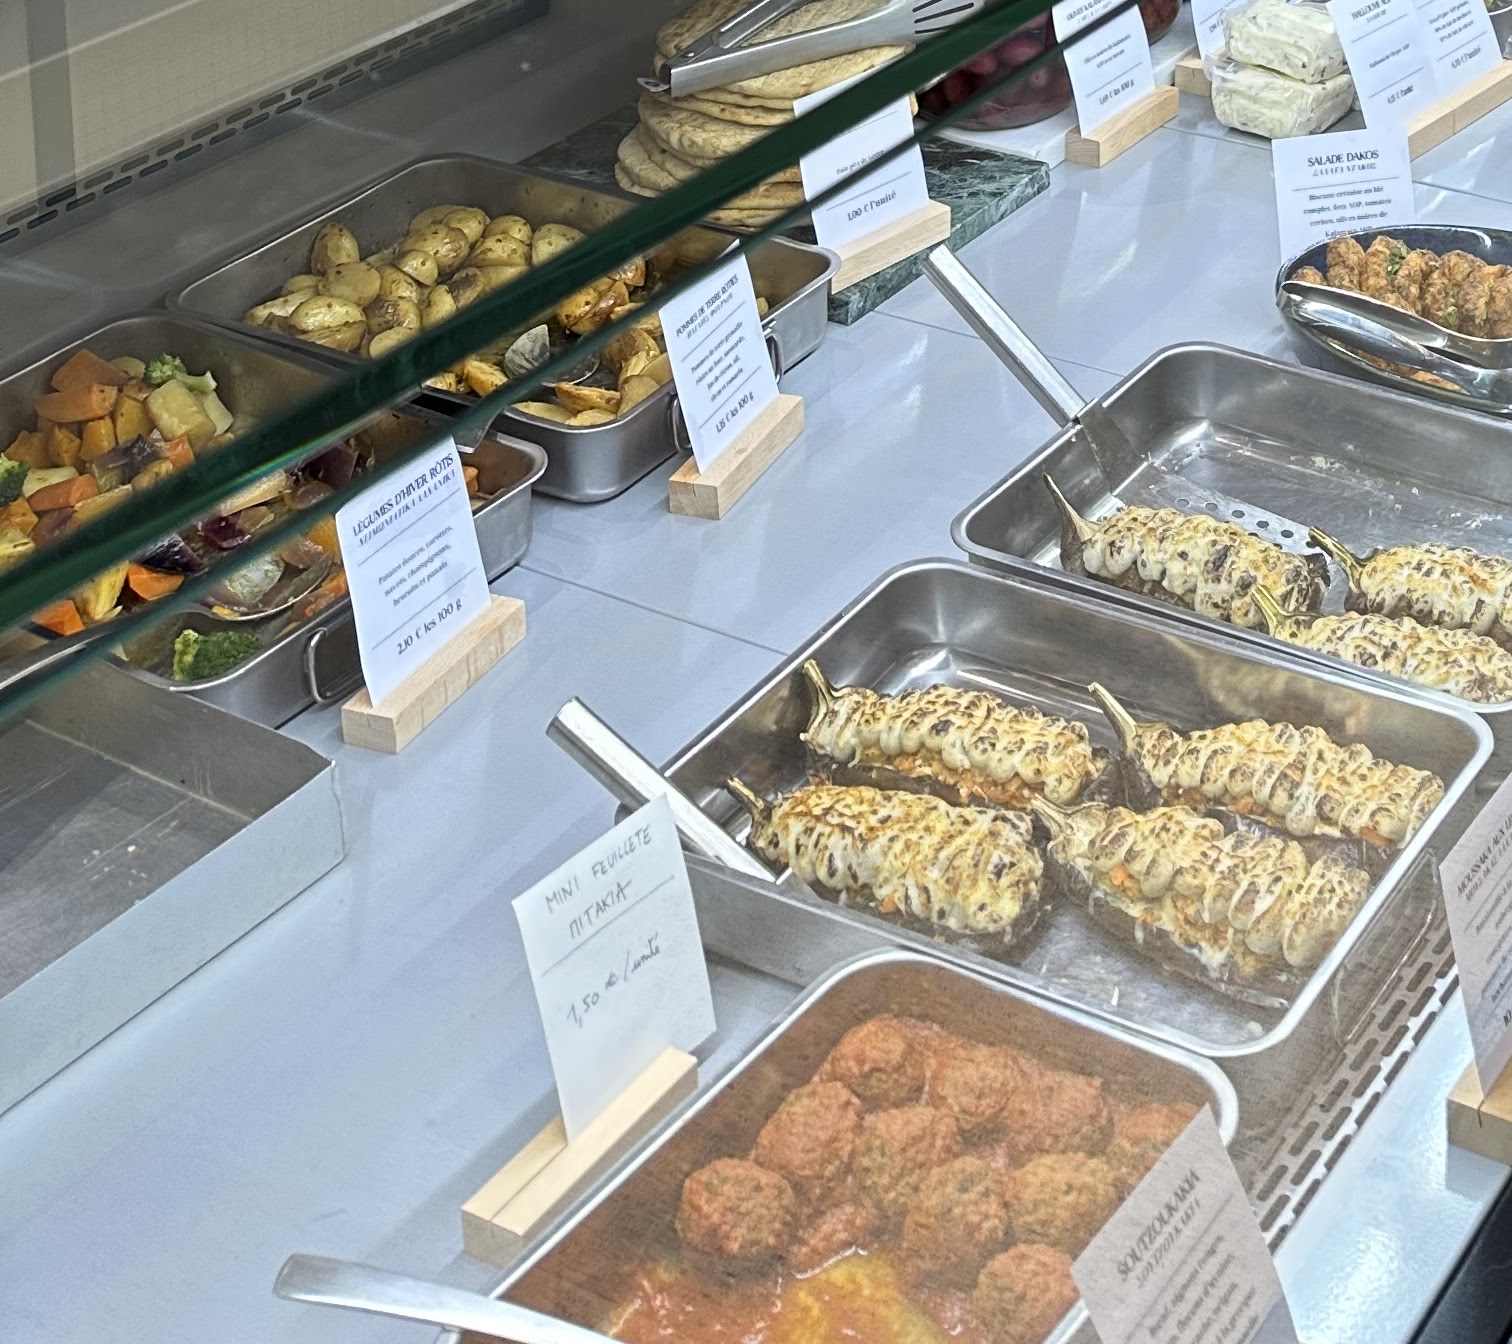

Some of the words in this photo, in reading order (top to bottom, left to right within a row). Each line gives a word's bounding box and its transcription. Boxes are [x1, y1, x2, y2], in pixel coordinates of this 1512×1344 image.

[1308, 154, 1344, 167] SALADE
[1346, 149, 1379, 162] DAKOS
[424, 620, 437, 634] les
[437, 604, 454, 624] 100
[455, 598, 462, 611] g
[545, 881, 582, 915] MINI
[590, 824, 654, 881] FEUILLETE
[568, 880, 634, 939] ΠΙΤΑΚΙΑ
[566, 991, 601, 1030] 1,50
[1117, 1169, 1200, 1282] SOUTZOUKAKIA
